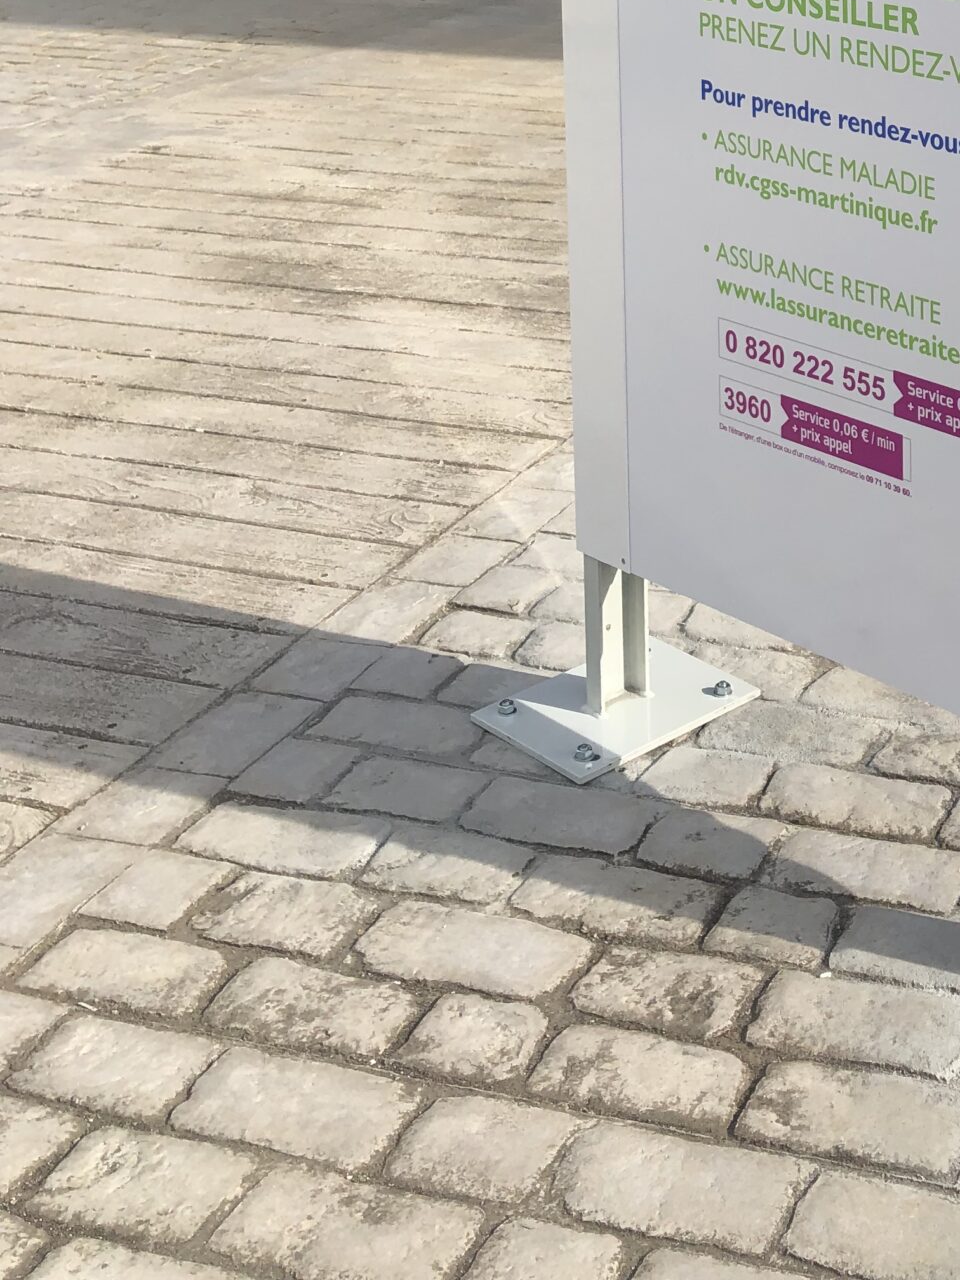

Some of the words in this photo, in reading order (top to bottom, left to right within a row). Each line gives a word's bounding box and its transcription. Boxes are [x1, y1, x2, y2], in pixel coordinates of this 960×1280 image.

[699, 12, 786, 52] PRENEZ
[793, 27, 831, 61] UN
[701, 79, 746, 108] Pour
[751, 95, 831, 127] prendre
[714, 129, 833, 176] ASSURANCE
[840, 157, 936, 201] MALADIE
[715, 163, 939, 234] rdv.cgss-martinique.fr
[715, 241, 835, 295] ASSURANCE
[841, 275, 942, 326] RETRAITE
[725, 330, 738, 353] 0
[745, 336, 785, 368] 820
[792, 350, 834, 385] 222
[842, 366, 886, 401] 555
[724, 387, 772, 423] 3960
[907, 380, 954, 409] Service
[917, 404, 942, 423] prix
[792, 404, 830, 430] Service
[832, 419, 859, 439] 0,06
[861, 429, 870, 443] €
[877, 436, 896, 452] min
[800, 427, 821, 443] prix
[823, 434, 853, 455] appel
